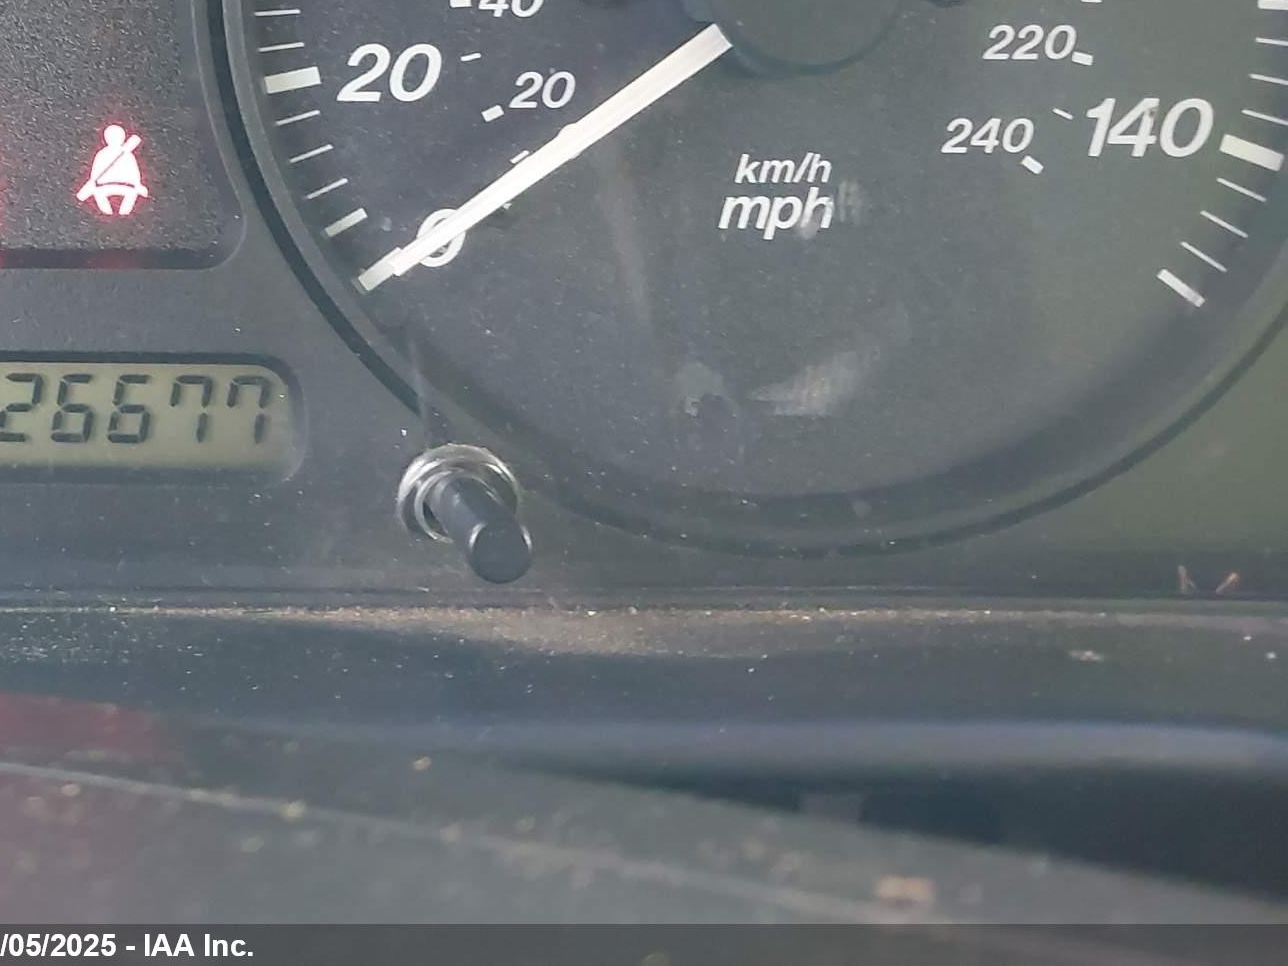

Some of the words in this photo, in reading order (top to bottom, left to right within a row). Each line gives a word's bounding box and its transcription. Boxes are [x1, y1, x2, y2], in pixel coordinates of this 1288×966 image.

[982, 24, 1076, 60] 220
[336, 43, 442, 102] 20
[509, 71, 576, 109] 20
[941, 117, 1035, 154] 240
[1086, 97, 1214, 158] 140
[734, 152, 832, 183] km/h
[718, 186, 834, 240] mph
